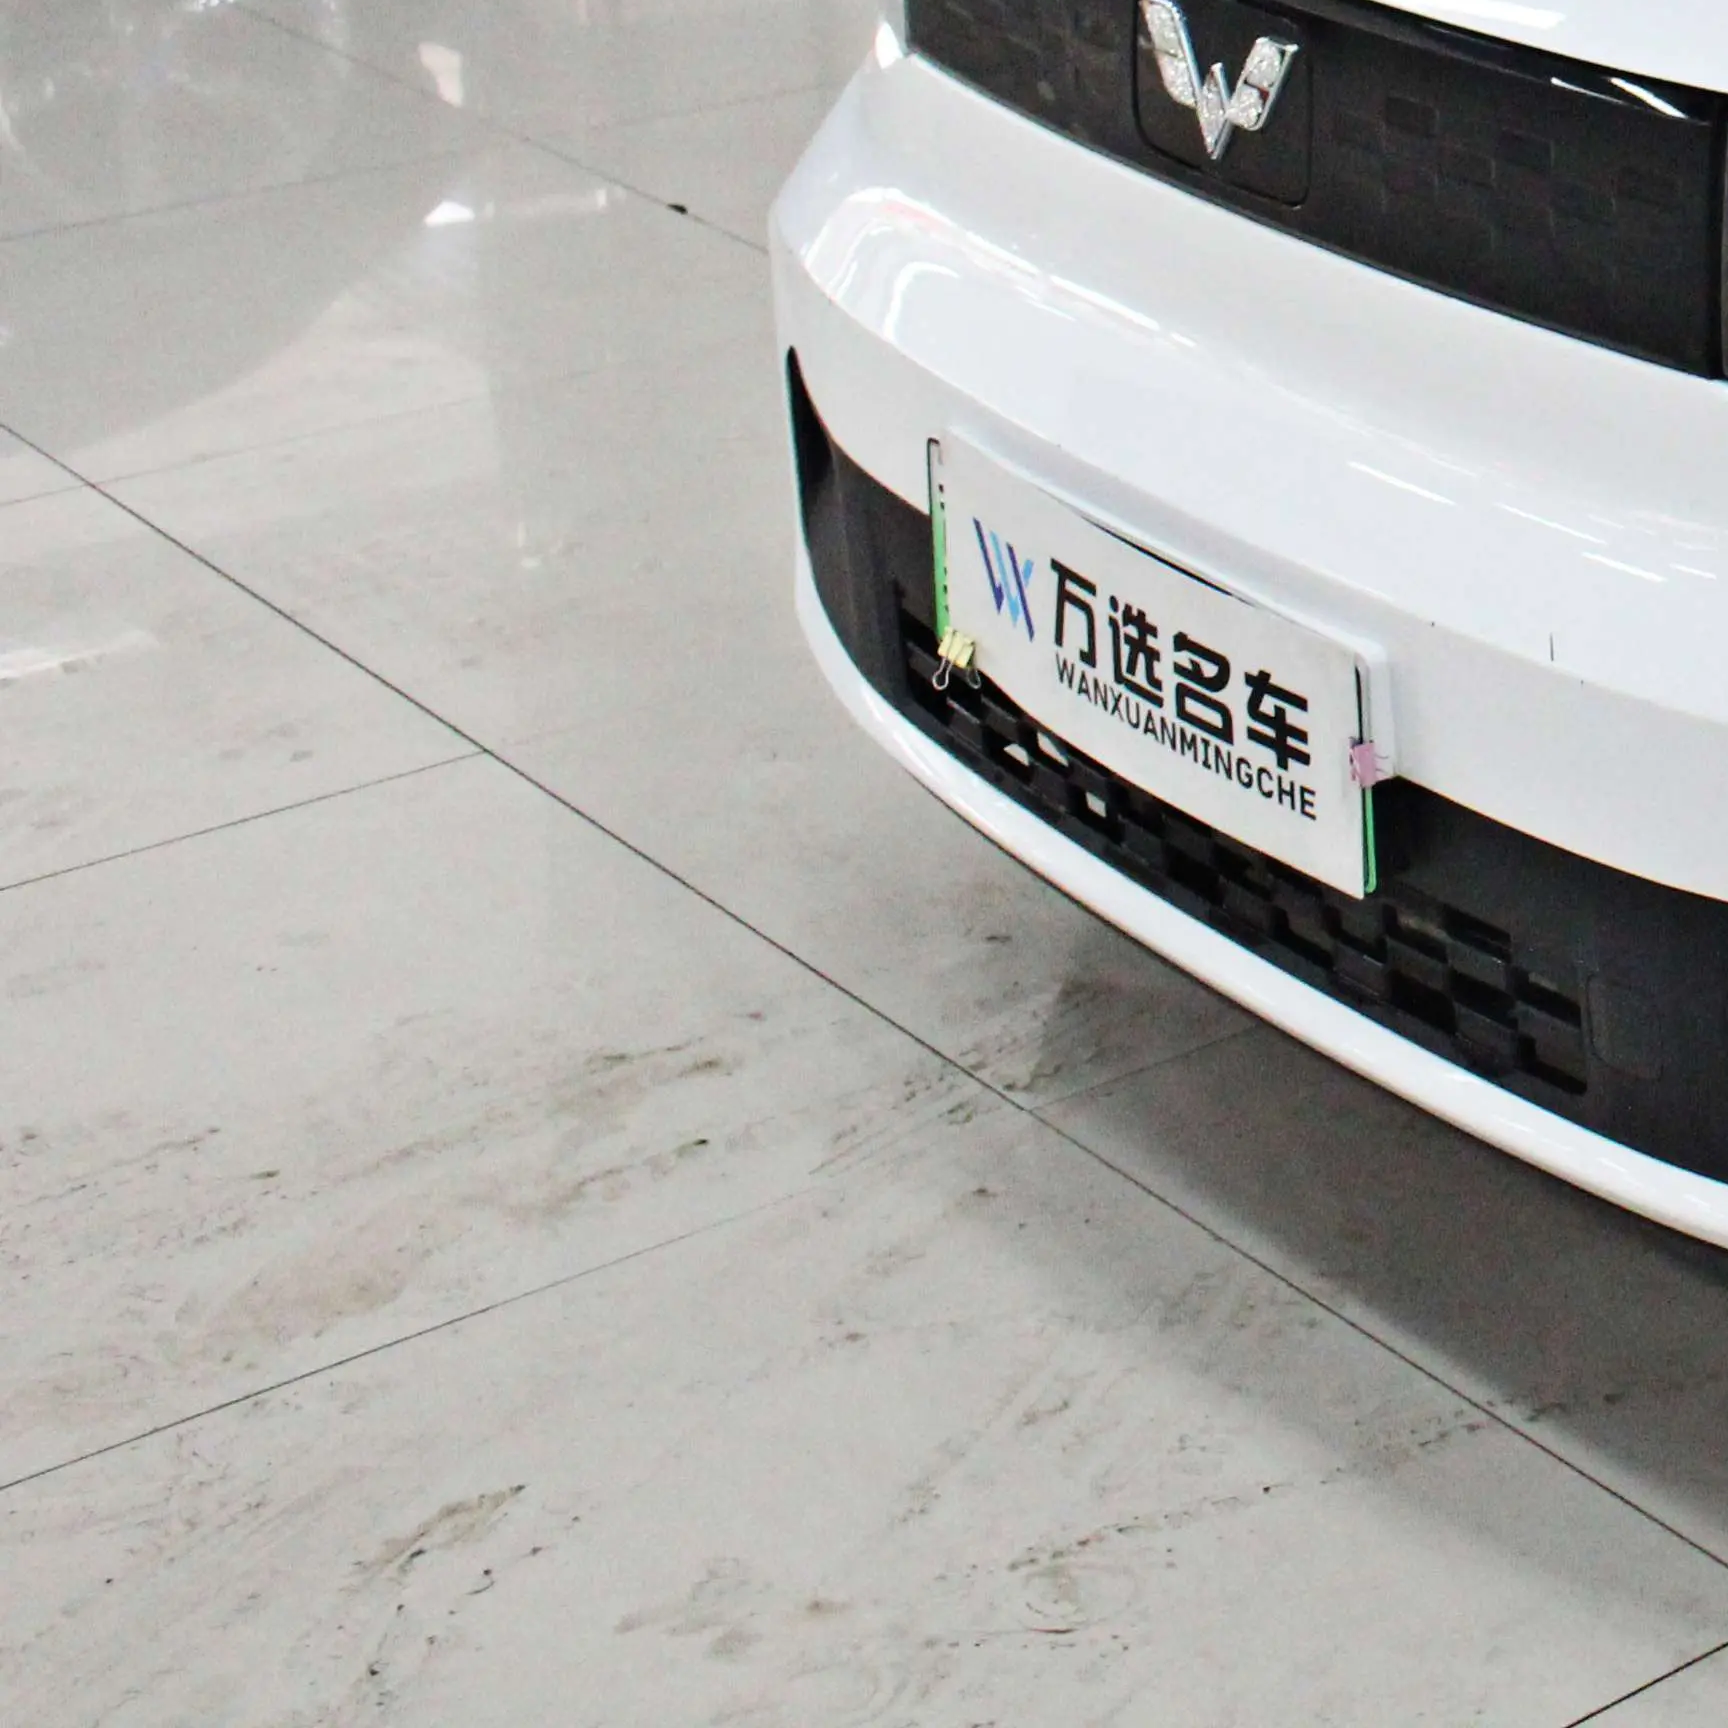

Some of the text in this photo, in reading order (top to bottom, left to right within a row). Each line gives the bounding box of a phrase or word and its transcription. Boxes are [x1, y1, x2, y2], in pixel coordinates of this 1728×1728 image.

[1050, 556, 1311, 772] 万选名车
[1055, 651, 1317, 821] WANXUANMINGCHE
